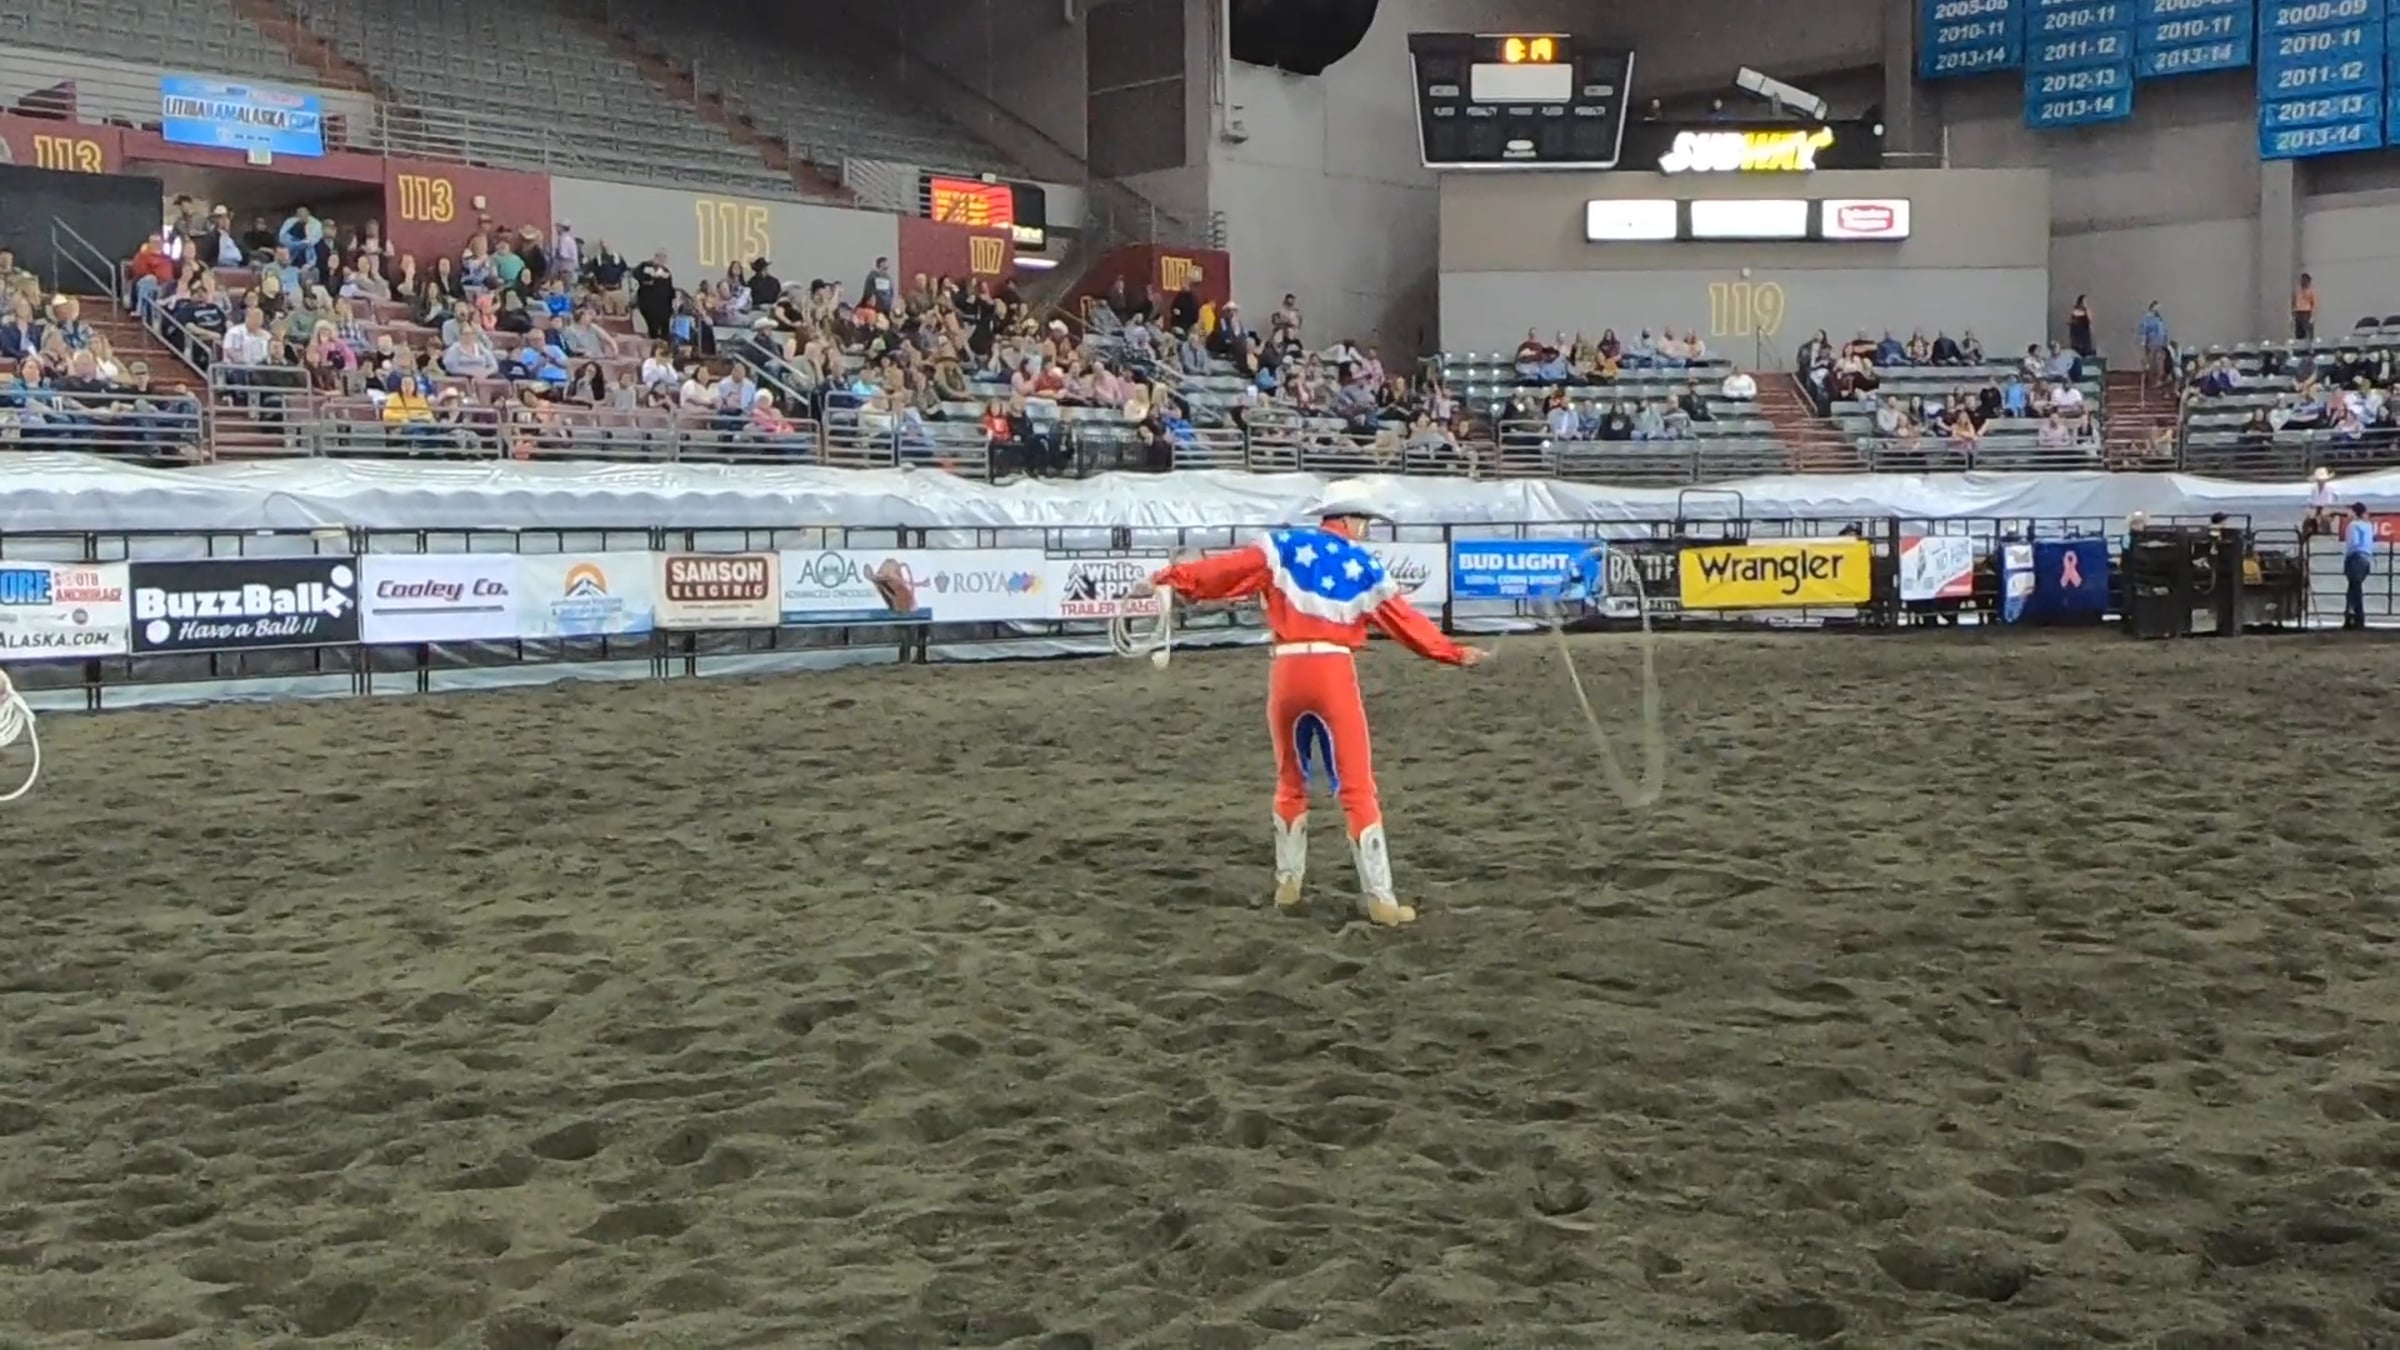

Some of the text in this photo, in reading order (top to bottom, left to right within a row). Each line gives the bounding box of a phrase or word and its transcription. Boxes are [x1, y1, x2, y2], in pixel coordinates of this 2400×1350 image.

[2044, 5, 2115, 30] 2010-11
[2156, 15, 2232, 41] 2010-11
[1938, 21, 2004, 43] 2010-11
[2279, 29, 2361, 55] 2010-11
[1935, 48, 2006, 70] 2013-14
[2044, 37, 2116, 61] 2011-12
[2155, 44, 2232, 69] 2013-14
[2042, 69, 2115, 92] 2012-13
[2278, 61, 2363, 88] 2011-12
[2041, 97, 2115, 119] 2013-14
[2278, 96, 2362, 121] 2012-13
[1657, 125, 1834, 173] SUBWAY
[2277, 126, 2361, 150] 2013-14
[34, 134, 103, 174] 113
[398, 174, 454, 222] 113
[695, 200, 771, 268] 115
[969, 235, 1005, 275] 117
[1708, 281, 1785, 337] 119
[671, 560, 764, 582] SAMSON
[1459, 552, 1569, 571] BUD LIGHT
[1697, 549, 1844, 596] Wrangler
[376, 577, 509, 601] Cooley Co.
[671, 583, 764, 598] ELECTRIC
[953, 569, 1013, 597] ROYA
[1061, 602, 1116, 616] TRAILER
[178, 621, 233, 641] Have
[234, 620, 252, 637] a
